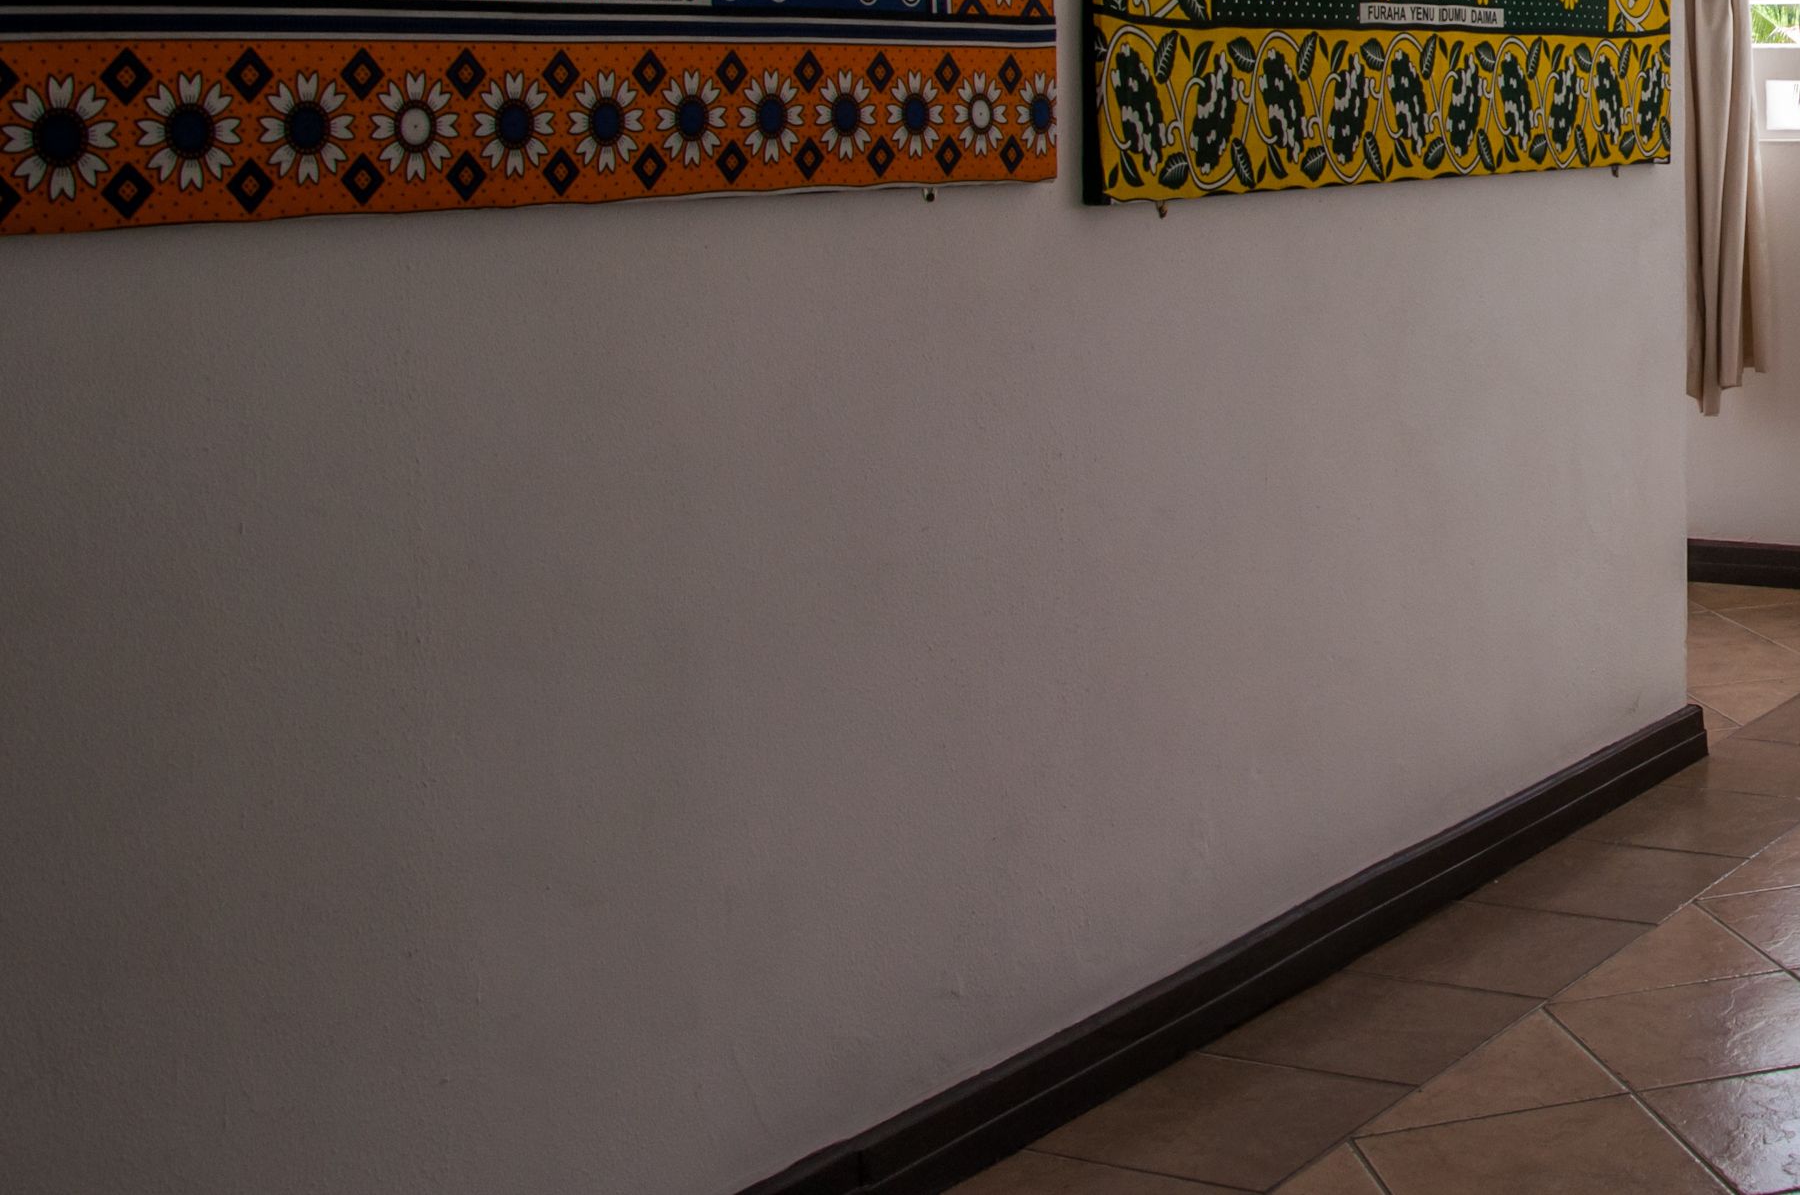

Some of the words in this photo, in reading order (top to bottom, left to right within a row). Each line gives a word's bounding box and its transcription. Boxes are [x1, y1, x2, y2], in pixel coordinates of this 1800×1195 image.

[1367, 5, 1406, 21] FURAHA
[1409, 7, 1435, 22] YENU
[1438, 8, 1467, 22] IDUMU
[1471, 9, 1498, 24] DAIMA
